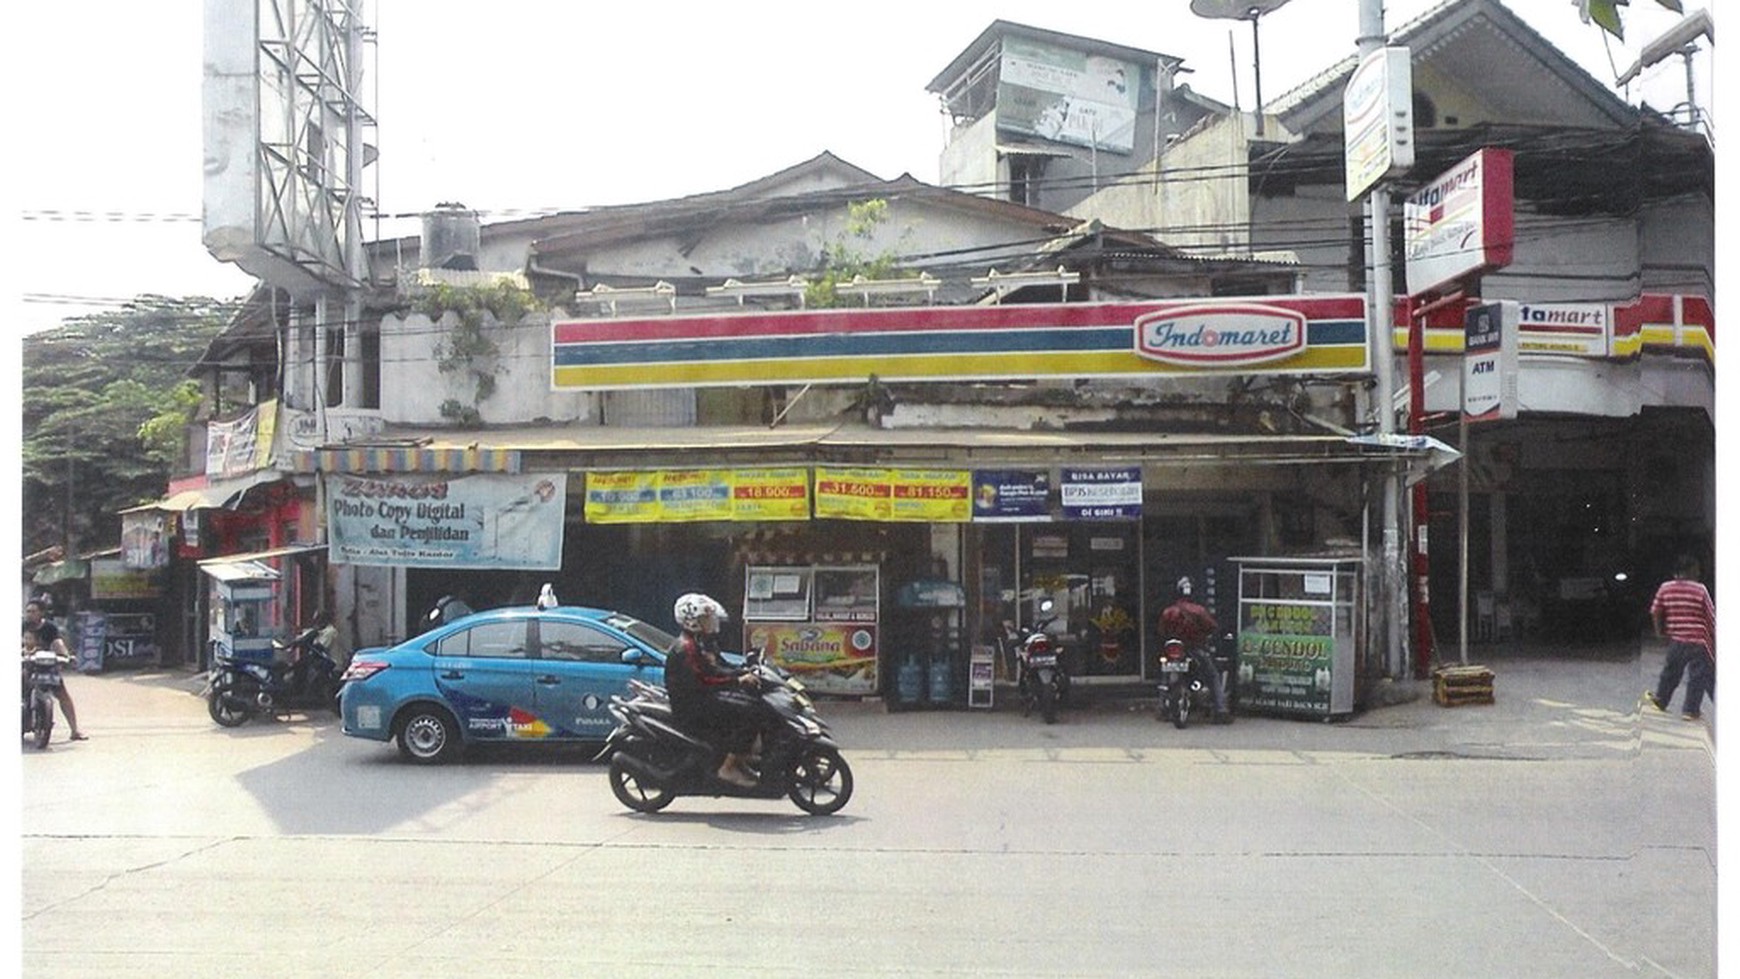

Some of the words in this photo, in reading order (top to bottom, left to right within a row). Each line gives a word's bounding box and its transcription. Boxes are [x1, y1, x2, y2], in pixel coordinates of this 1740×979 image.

[1150, 321, 1291, 347] Indomaret
[1472, 360, 1494, 374] ATM
[1071, 472, 1094, 480] BISA
[1097, 471, 1131, 480] BAYAR
[334, 499, 374, 518] Photo
[378, 501, 412, 524] Copy
[416, 502, 465, 524] Digital
[1081, 509, 1092, 517] DI
[370, 525, 395, 539] dan
[400, 526, 470, 544] Penjilidan
[418, 551, 454, 559] Kantor
[781, 638, 840, 652] Sabana
[1262, 640, 1328, 661] CENDOL
[469, 722, 503, 730] AIRPORT
[512, 723, 533, 731] TAXI
